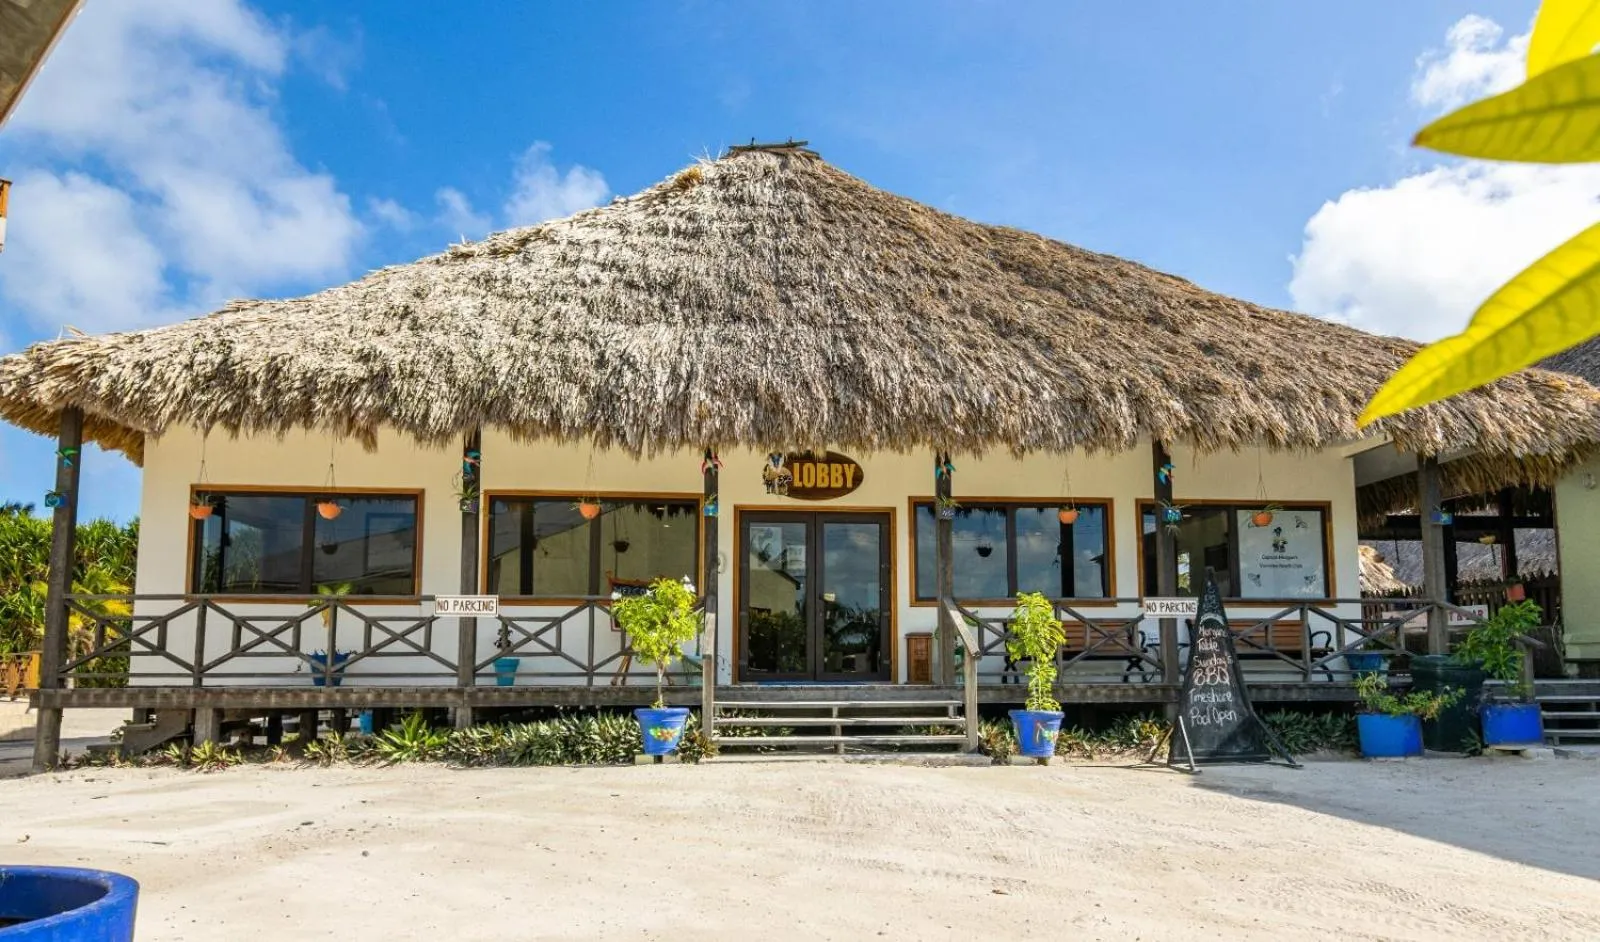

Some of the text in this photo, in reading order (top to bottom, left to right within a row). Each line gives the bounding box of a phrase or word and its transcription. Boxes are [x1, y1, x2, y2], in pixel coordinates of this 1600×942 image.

[793, 462, 856, 488] LOBBY
[437, 600, 495, 612] NO PARKING
[1146, 602, 1197, 613] NO PARKING
[1193, 666, 1230, 686] BBQ
[1190, 705, 1238, 728] Pool Open
